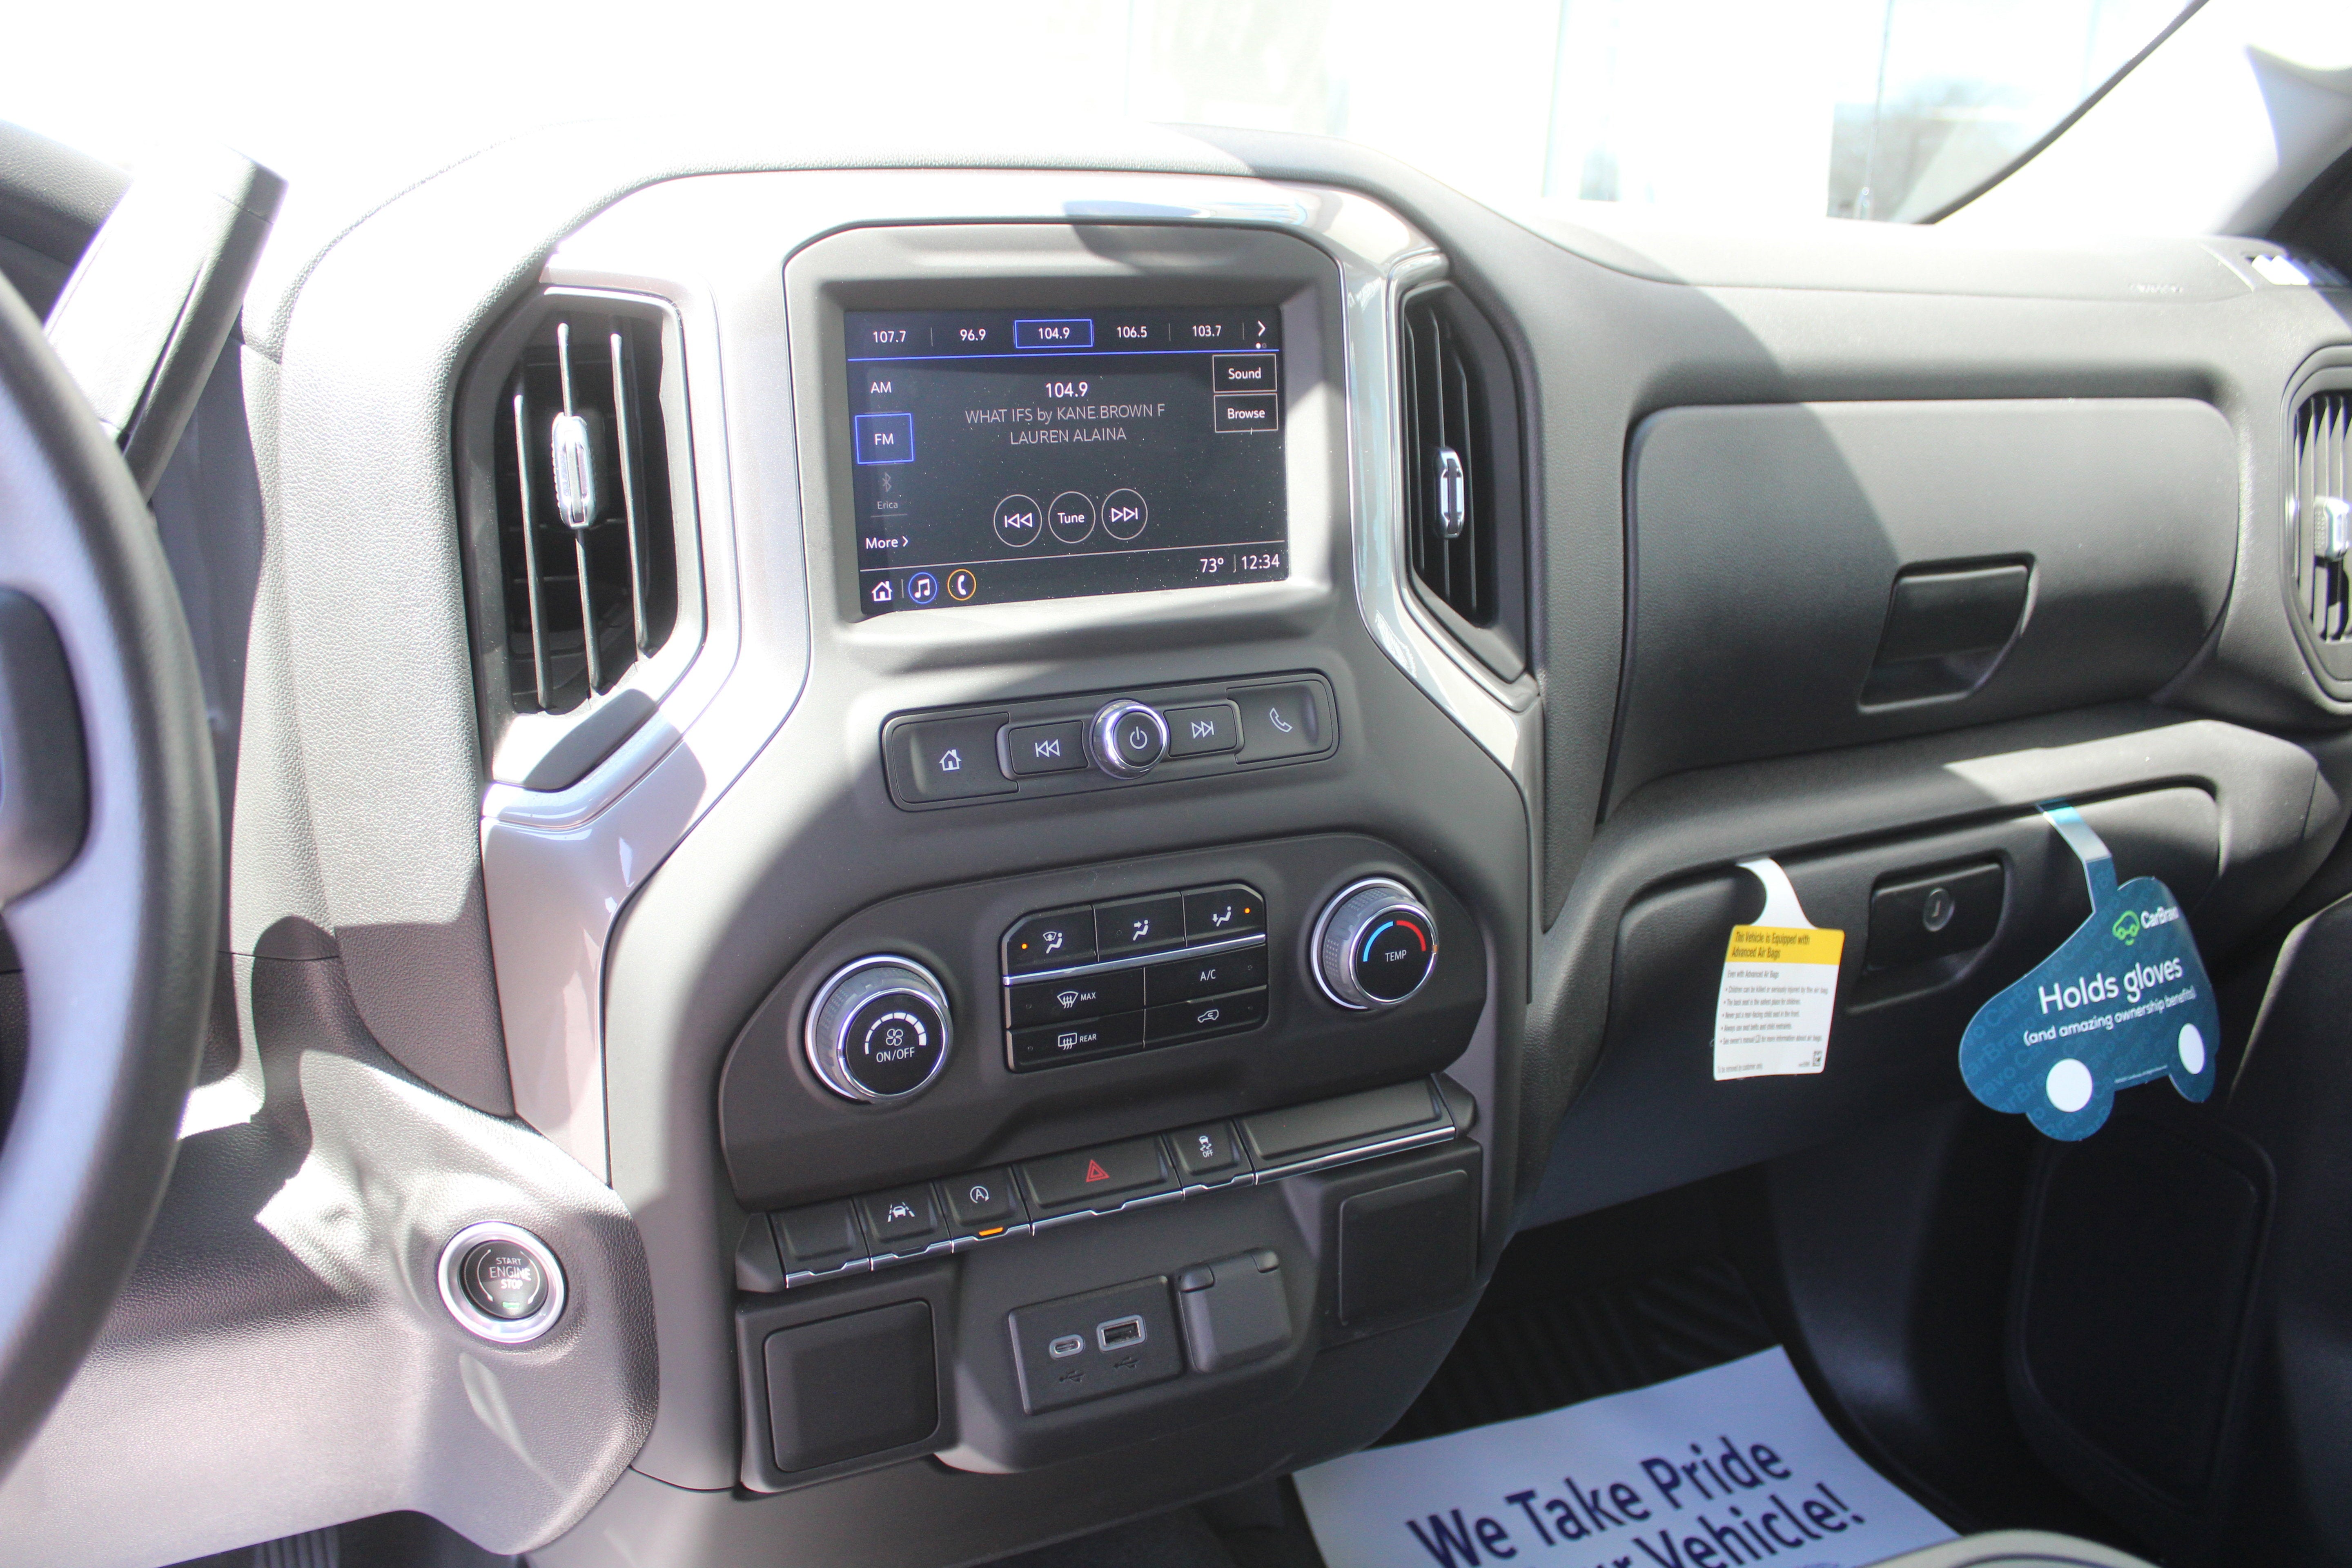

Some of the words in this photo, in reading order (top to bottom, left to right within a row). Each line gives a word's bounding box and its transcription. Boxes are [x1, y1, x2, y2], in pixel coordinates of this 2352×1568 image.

[873, 330, 906, 343] 107.7
[960, 328, 986, 341] 96.9
[1038, 327, 1070, 339] 104.9
[1117, 326, 1147, 339] 106.5
[1192, 325, 1221, 337] 103.7
[1228, 368, 1262, 380] Sound
[871, 382, 891, 393] AM
[1046, 382, 1088, 398] 104.9
[965, 410, 1007, 423] WHAT
[1012, 408, 1033, 422] IFS
[1038, 408, 1052, 425] by
[1102, 404, 1152, 419] BROWN
[1158, 404, 1165, 416] F
[1227, 408, 1265, 420] Browse
[874, 433, 894, 445] FM
[1010, 429, 1069, 445] LAUREN
[1073, 427, 1127, 442] ALAINA
[877, 501, 898, 509] Erica
[1057, 512, 1085, 524] Tune
[865, 537, 898, 549] More
[1241, 553, 1280, 570] 12:34
[1735, 931, 1744, 943] This
[1746, 932, 1764, 944] Vehicle
[1766, 933, 1771, 944] is
[1772, 933, 1797, 946] Equipped
[1798, 934, 1810, 945] with
[1385, 950, 1407, 962] TEMP
[1732, 947, 1756, 958] Advanced
[1767, 948, 1781, 960] Bags
[1200, 969, 1216, 981] A/C
[2038, 972, 2119, 1014] Holds
[2124, 957, 2183, 1003] gloves
[1080, 992, 1096, 1001] MAX
[2023, 1025, 2057, 1047] (and
[2058, 1013, 2114, 1031] amazing
[2114, 999, 2164, 1024] ownership
[1079, 1033, 1097, 1043] REAR
[876, 1047, 915, 1062] ON/OFF
[1203, 1149, 1214, 1158] OFF
[496, 1257, 521, 1265] START
[489, 1266, 532, 1281] ENGINE
[501, 1279, 523, 1289] STOP
[1406, 1508, 1518, 1568] We
[1504, 1476, 1652, 1546] Take
[1640, 1435, 1792, 1510] Pride
[1632, 1481, 1866, 1568] Vehicle!
